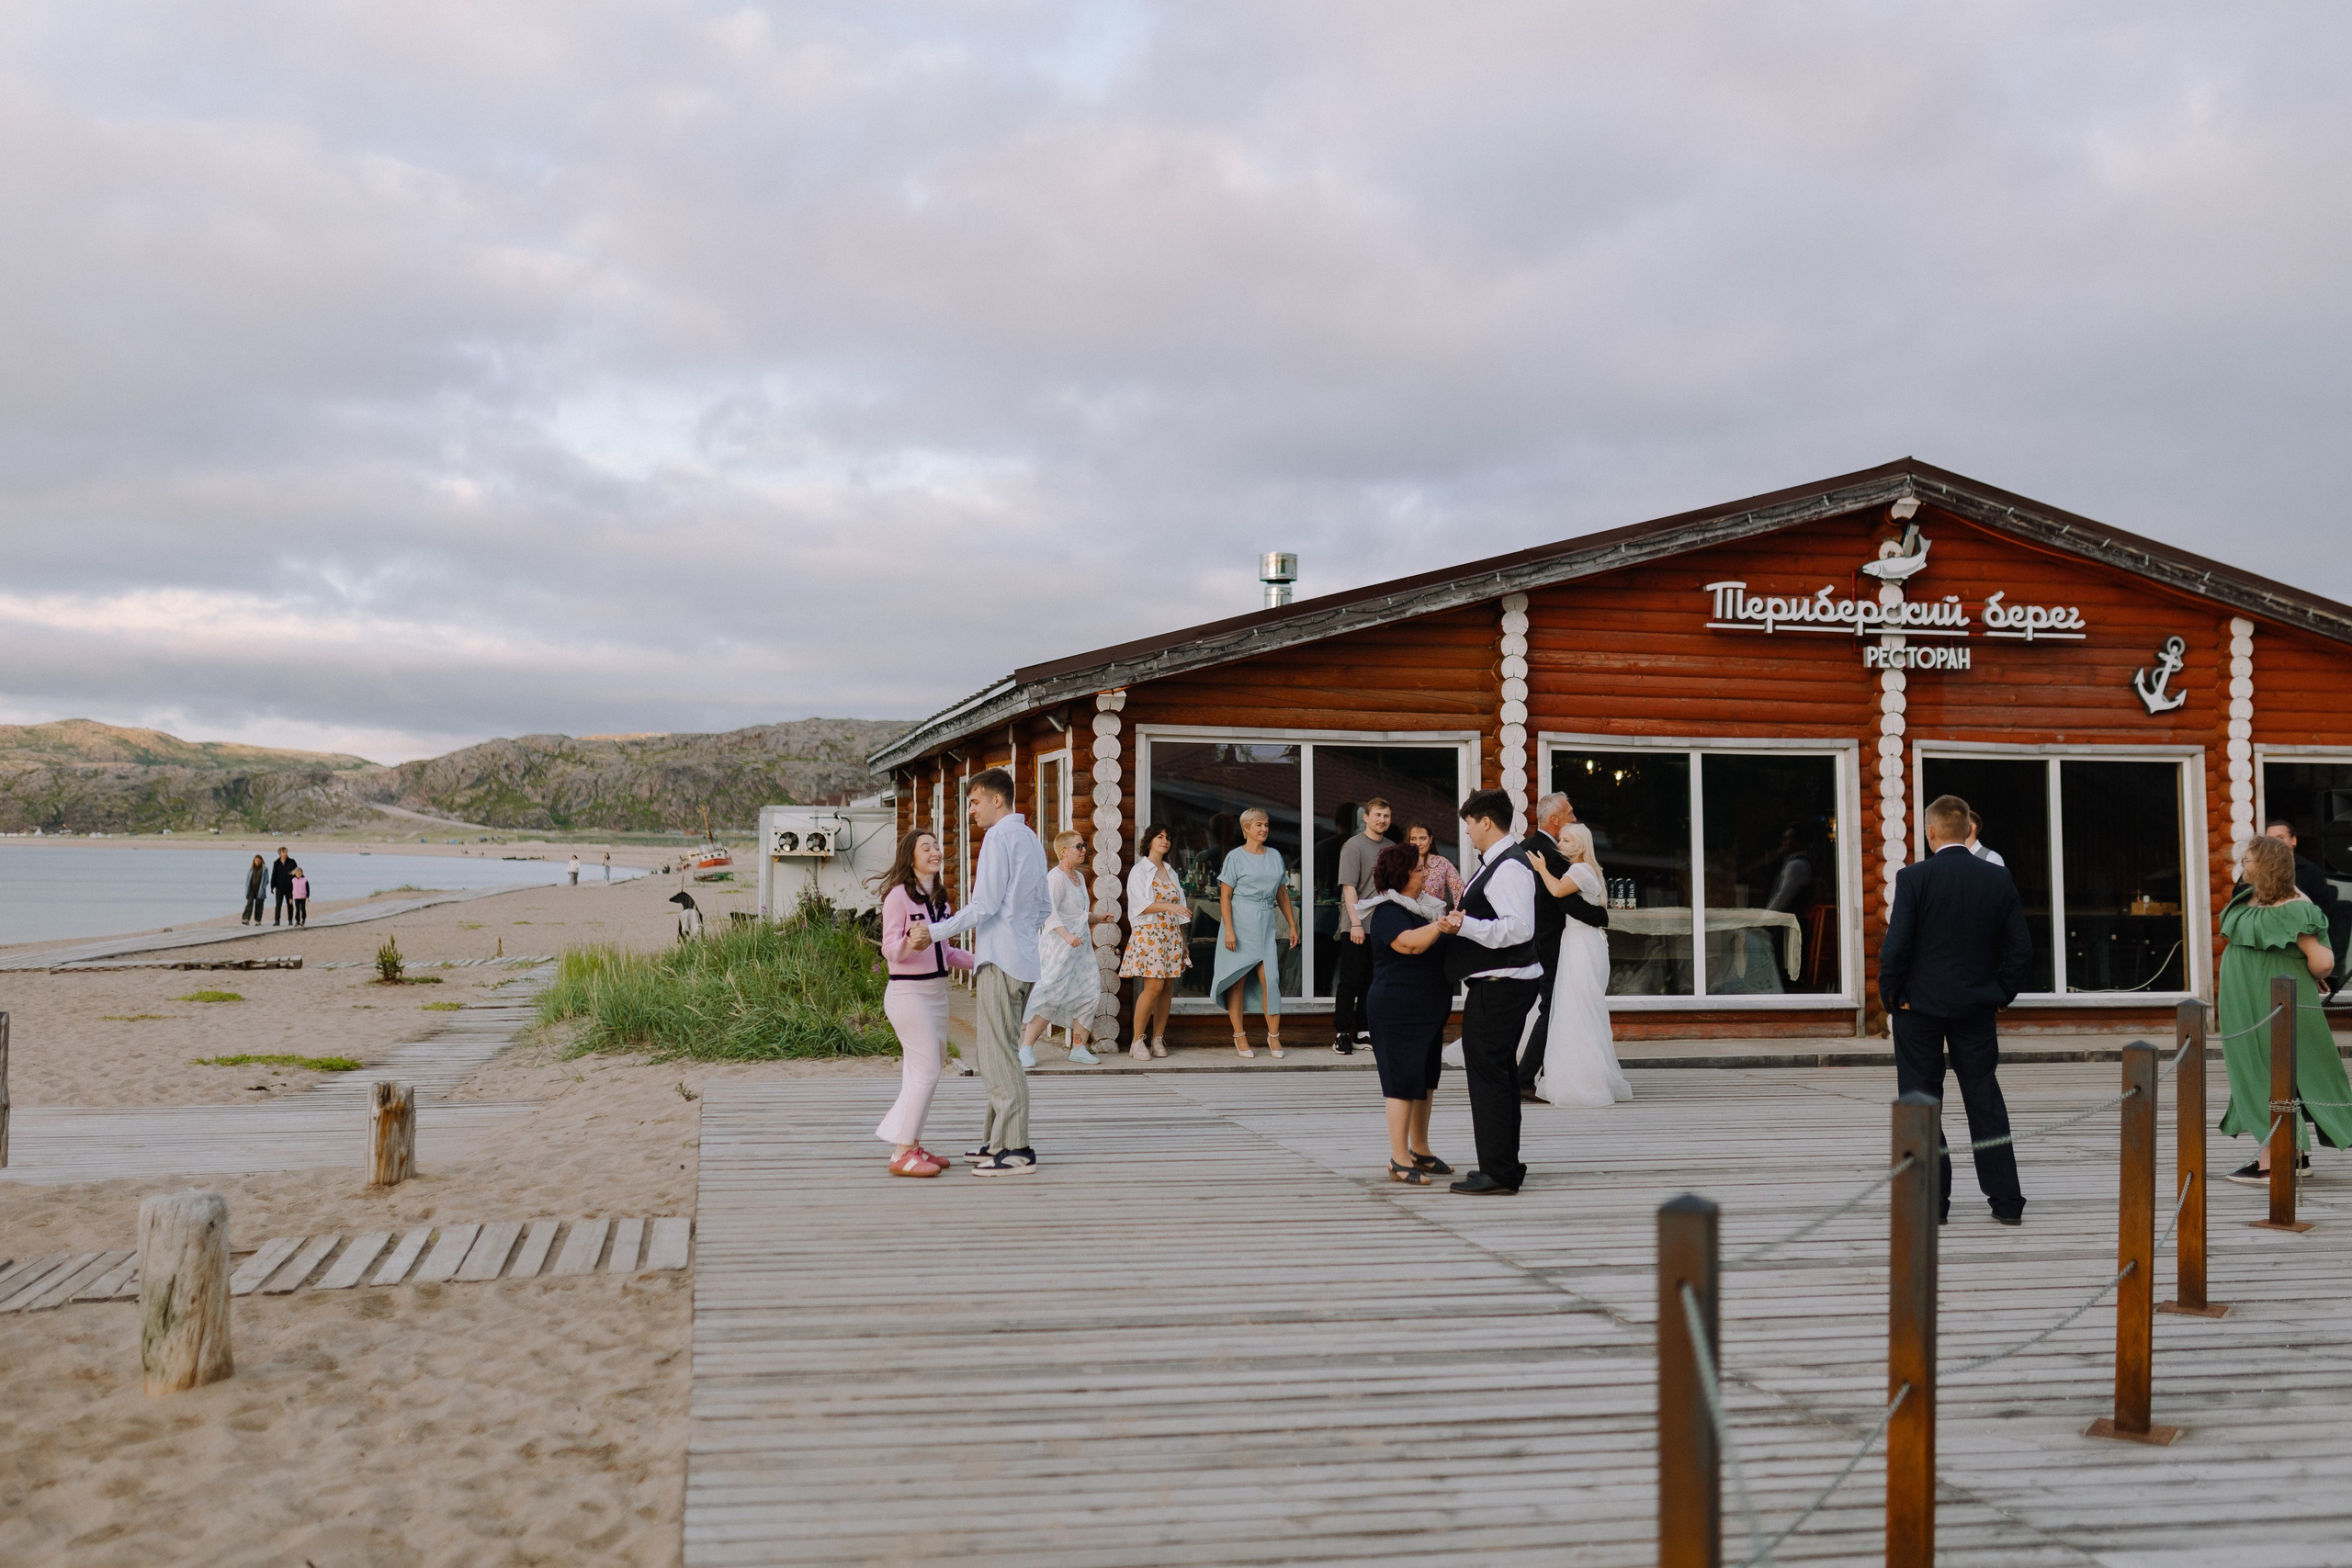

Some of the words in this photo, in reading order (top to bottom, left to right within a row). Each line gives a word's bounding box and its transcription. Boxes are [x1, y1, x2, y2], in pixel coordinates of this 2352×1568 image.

[1705, 581, 1971, 636] Териберский
[1983, 591, 2086, 641] берег
[1865, 646, 1971, 669] РЕСТОРАН
